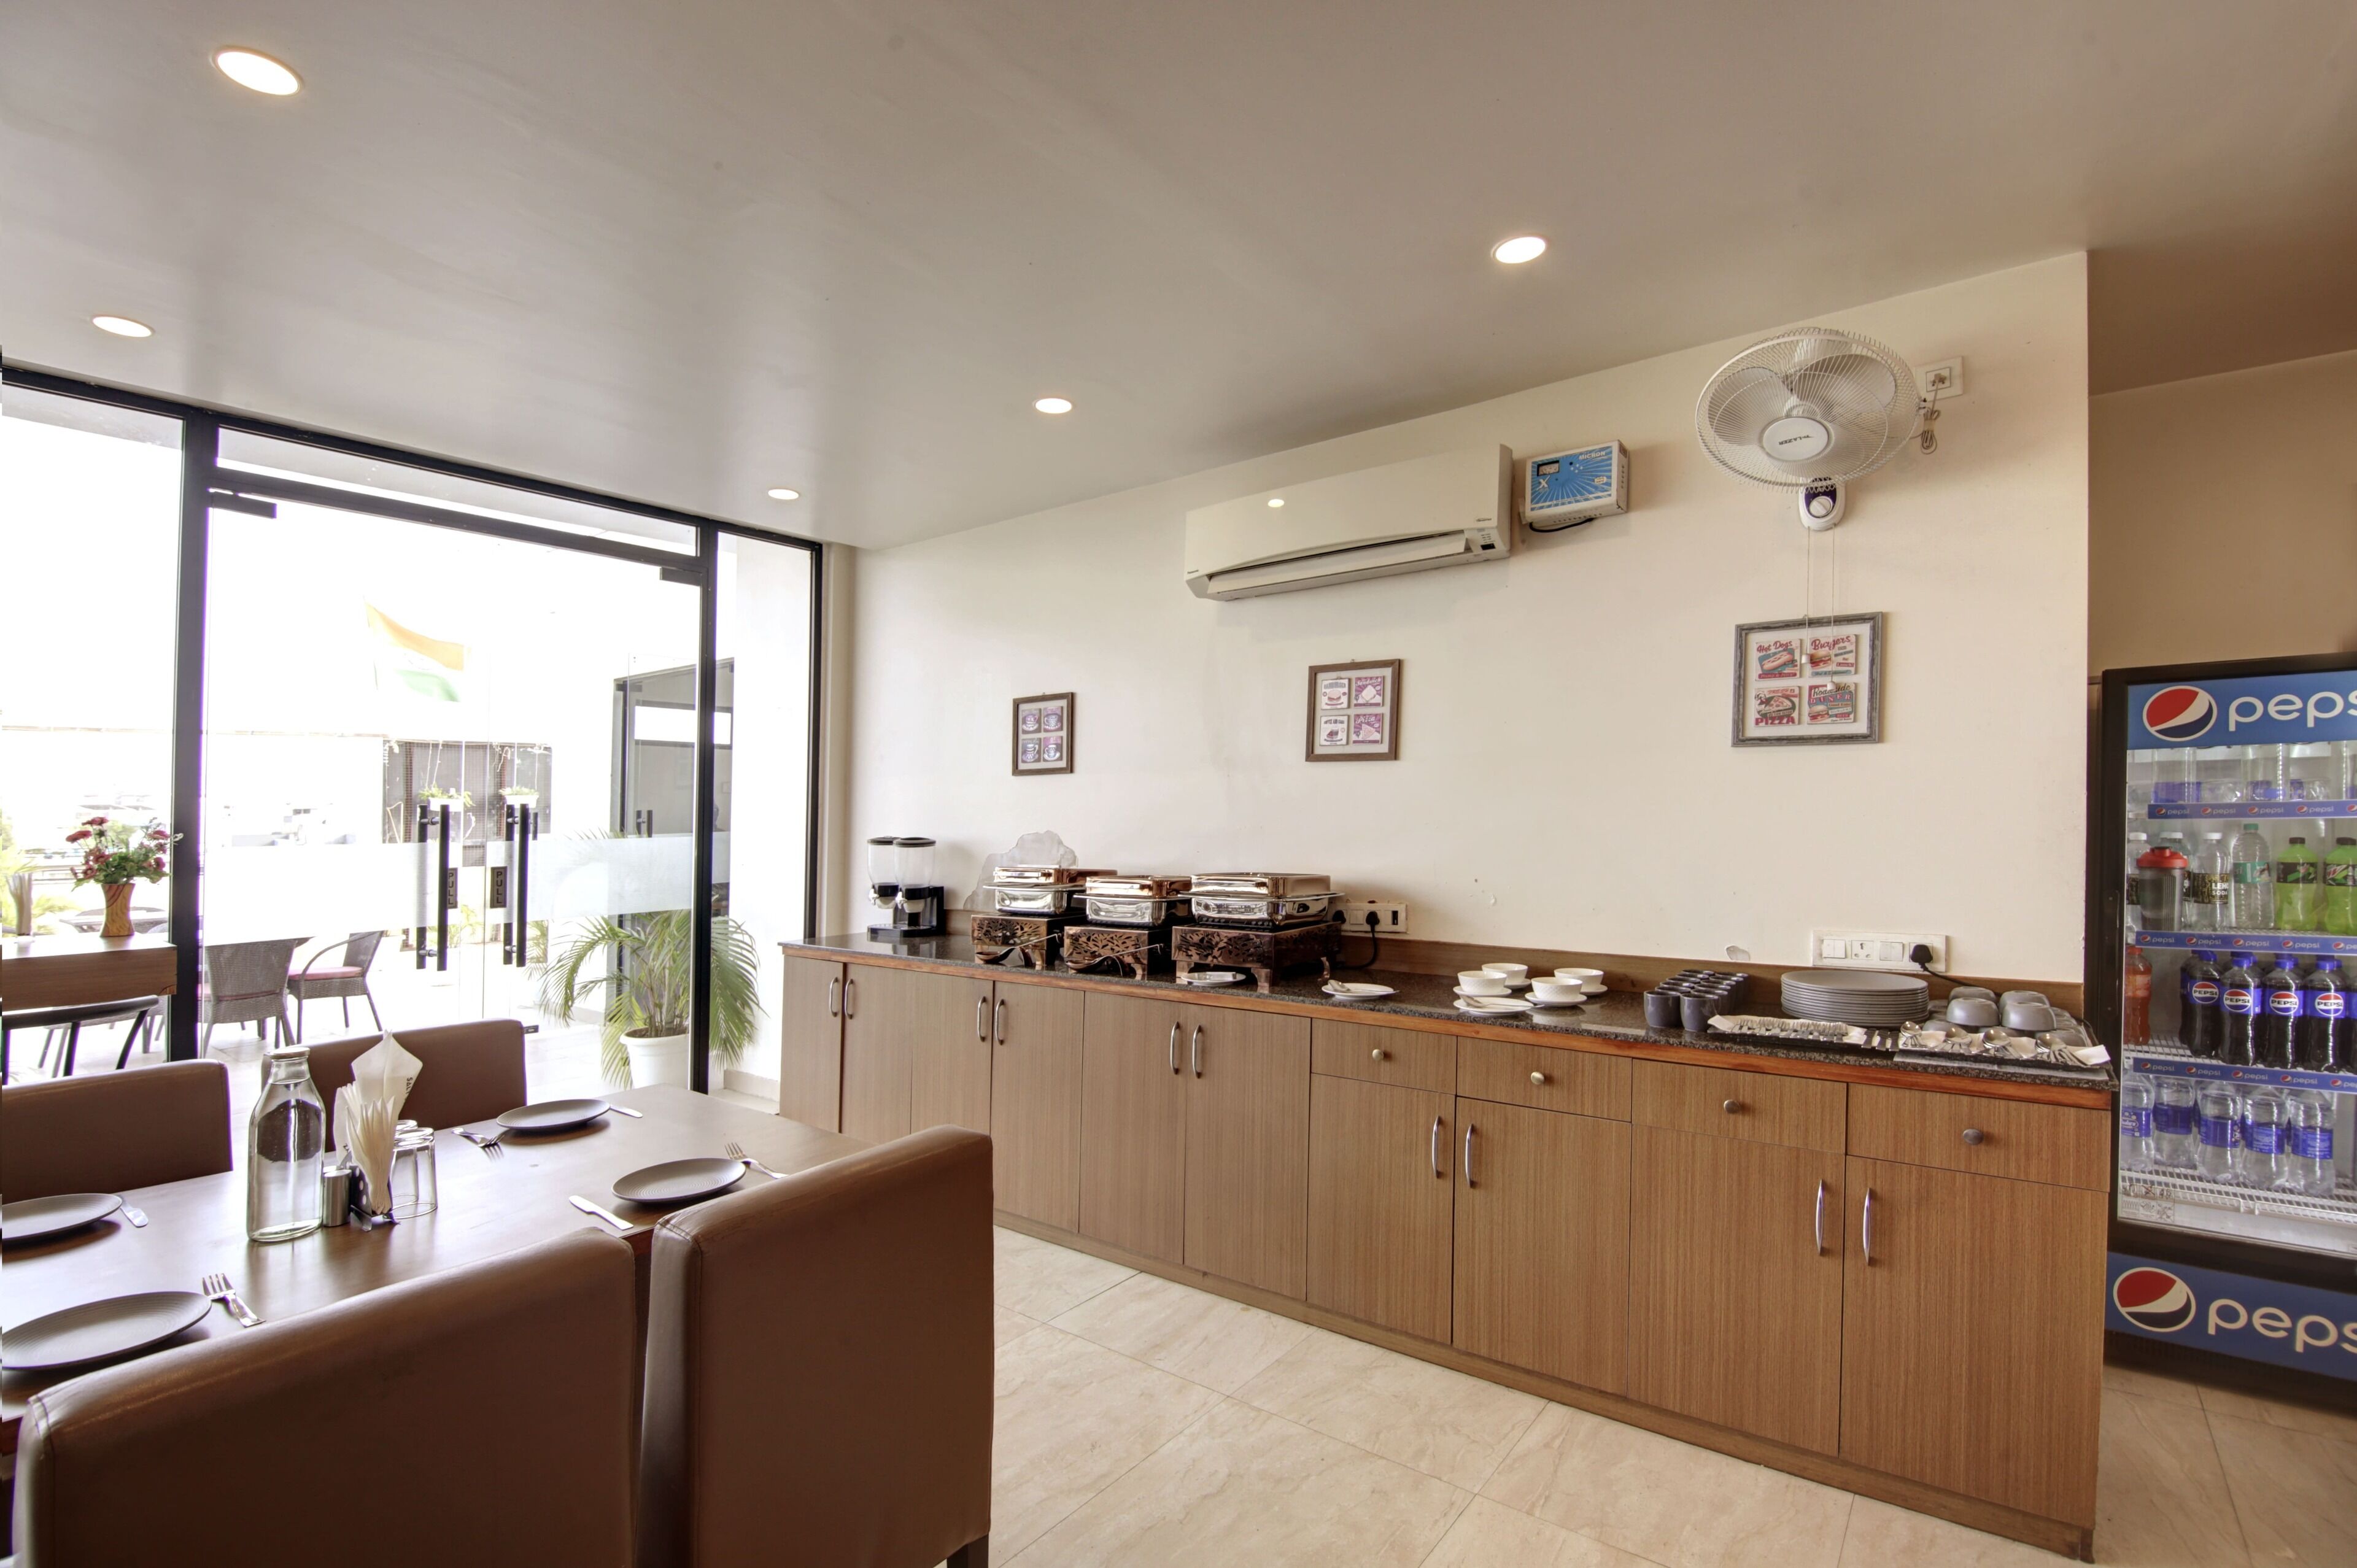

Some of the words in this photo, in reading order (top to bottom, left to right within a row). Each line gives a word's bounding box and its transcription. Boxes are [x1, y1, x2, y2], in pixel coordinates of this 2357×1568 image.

[1757, 644, 1771, 653] Hot
[1773, 641, 1792, 651] Dogs
[1811, 636, 1851, 651] Burgers
[1810, 693, 1851, 703] DINER
[1755, 716, 1795, 725] PIZZA
